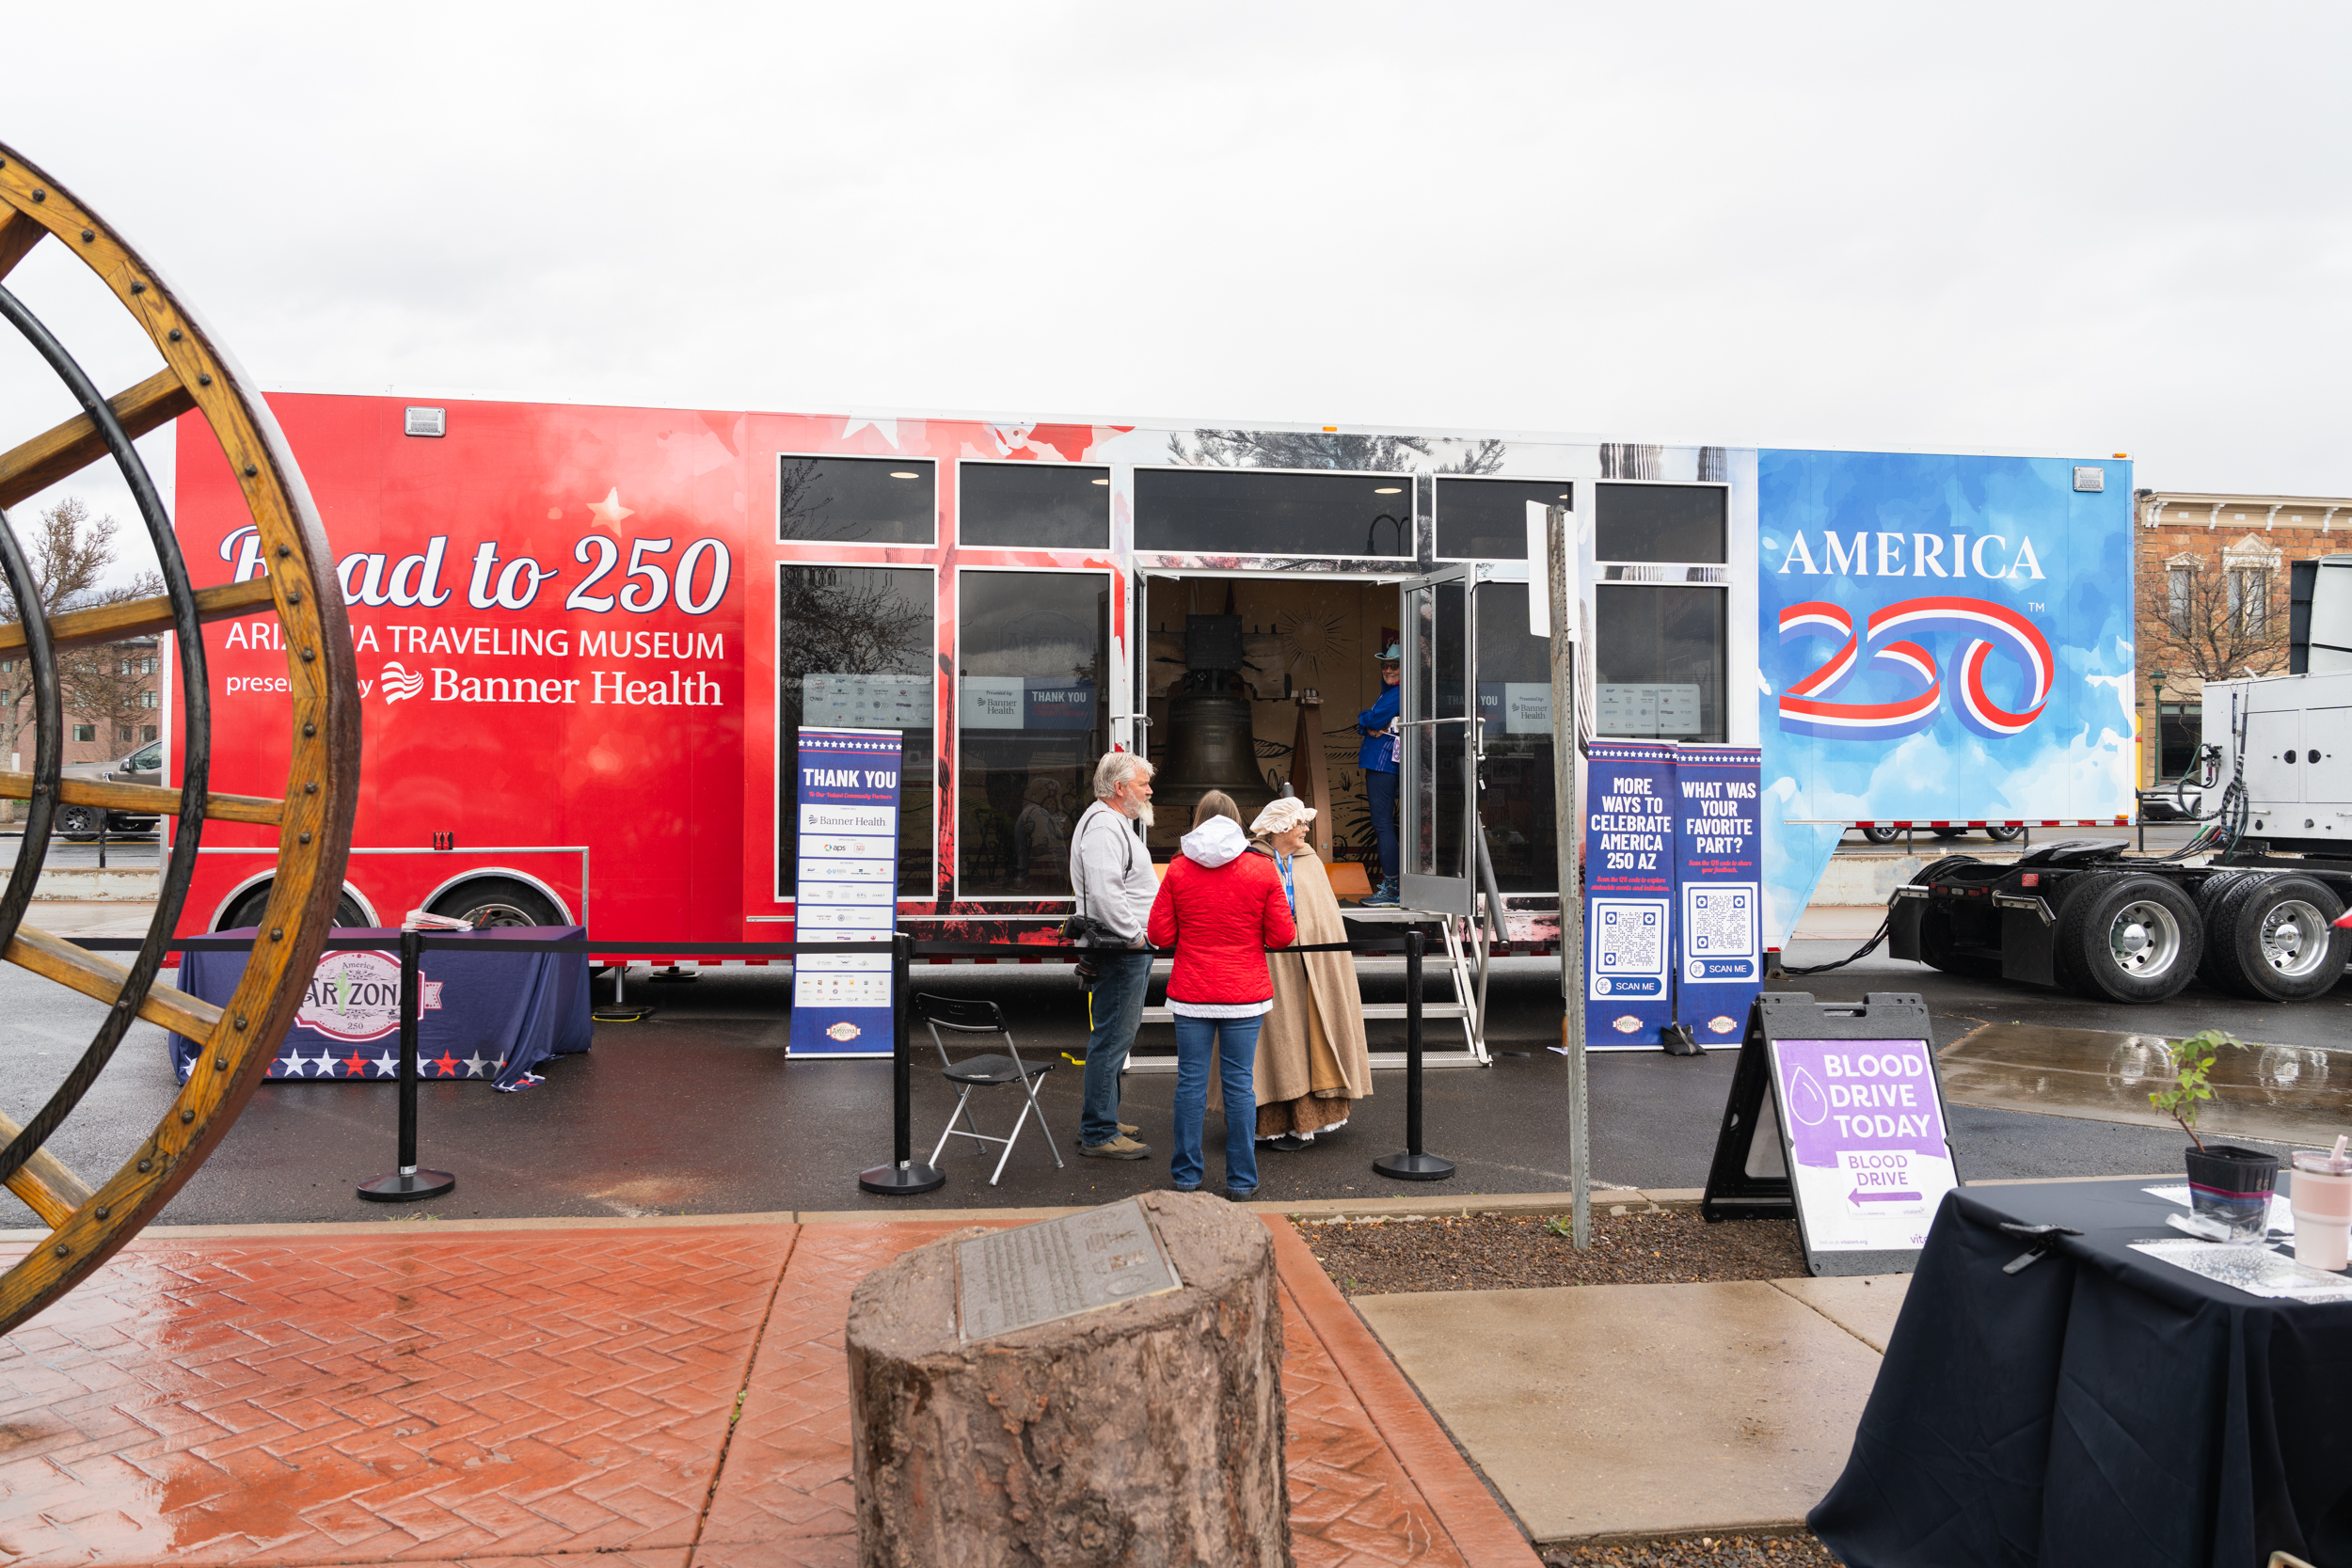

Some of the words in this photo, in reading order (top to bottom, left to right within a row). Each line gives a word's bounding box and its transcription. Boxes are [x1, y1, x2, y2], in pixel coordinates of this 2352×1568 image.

[1777, 529, 2046, 579] AMERICA
[468, 541, 560, 610] to
[565, 534, 732, 616] 250
[225, 622, 380, 653] ARIA
[387, 625, 568, 657] TRAVELING
[579, 630, 724, 659] MUSEUM
[1779, 596, 2055, 741] 250
[431, 667, 580, 704] Banner
[591, 670, 723, 706] Health
[988, 698, 1017, 707] Banner
[1031, 690, 1065, 703] THANK
[1067, 691, 1087, 703] YOU
[1480, 695, 1498, 706] YOU
[1520, 704, 1548, 712] Banner
[803, 768, 860, 788] THANK
[865, 770, 897, 789] YOU
[1613, 777, 1653, 795] MORE
[844, 792, 871, 800] Community
[1681, 782, 1723, 799] WHAT
[1725, 782, 1756, 799] WAS
[1602, 796, 1642, 814] WAYS
[1645, 797, 1663, 814] TO
[1700, 800, 1739, 816] YOUR
[819, 816, 854, 826] Banner
[1591, 815, 1672, 833] CELEBRATE
[1686, 818, 1753, 835] FAVORITE
[1600, 833, 1663, 851] AMERICA
[1696, 836, 1743, 854] PART?
[1607, 852, 1634, 870] 250
[1638, 853, 1657, 870] AZ
[1710, 859, 1719, 867] QR
[342, 961, 375, 971] America
[1708, 965, 1733, 974] SCAN
[1615, 982, 1641, 990] SCAN
[1642, 982, 1655, 990] ME
[1823, 1054, 1924, 1077] BLOOD
[1829, 1085, 1917, 1108] DRIVE
[1833, 1115, 1931, 1138] TODAY
[1848, 1154, 1908, 1169] BLOOD
[1856, 1171, 1909, 1186] DRIVE
